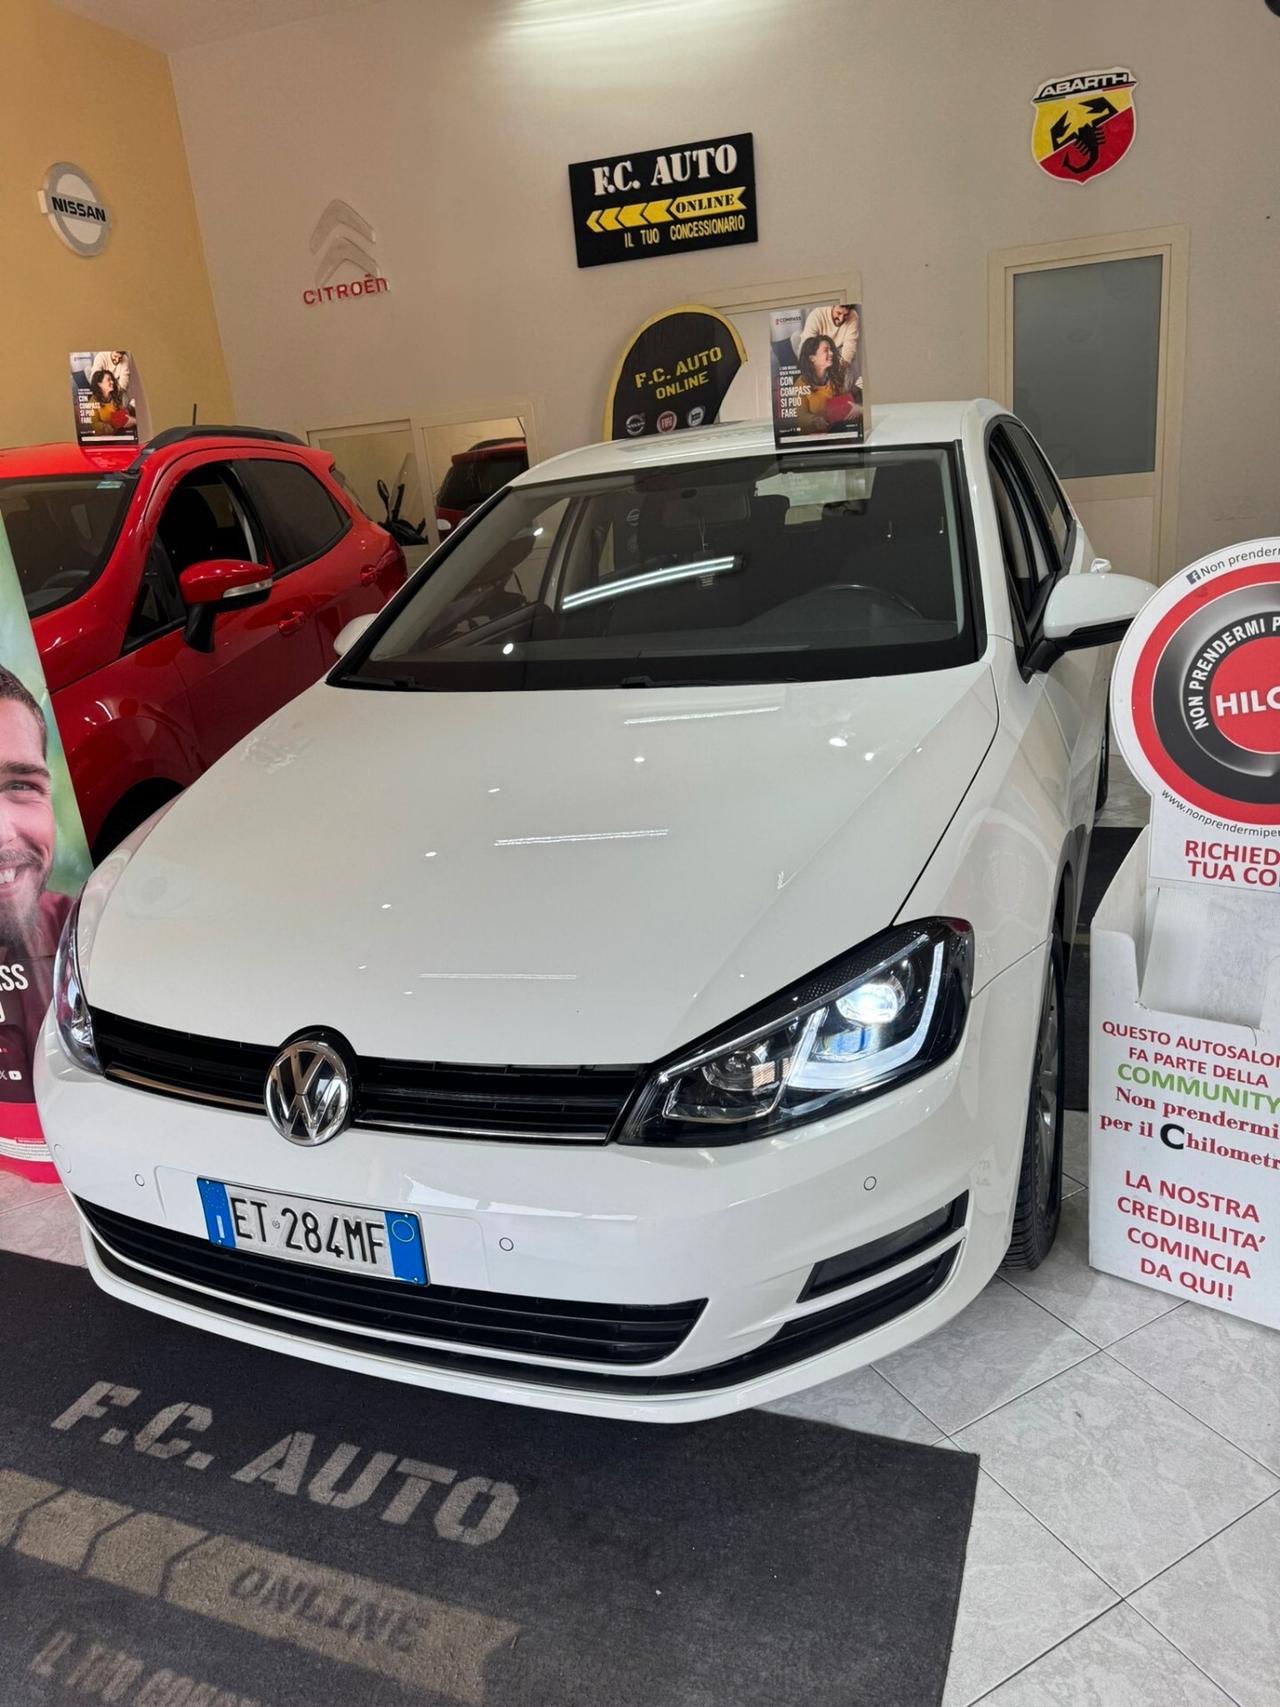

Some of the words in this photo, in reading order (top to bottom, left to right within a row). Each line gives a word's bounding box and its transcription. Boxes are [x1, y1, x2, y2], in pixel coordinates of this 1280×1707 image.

[1041, 74, 1128, 97] ABARTH
[592, 160, 641, 196] F.C.
[651, 144, 738, 187] AUTO
[51, 196, 107, 222] NISSAN
[675, 193, 735, 214] ONLINE
[624, 232, 635, 248] IL
[640, 228, 660, 245] TUO
[670, 214, 746, 241] CONCESSIONARIO
[634, 368, 672, 389] F.C.
[675, 346, 722, 377] AUTO
[655, 371, 710, 399] ONLINE
[1200, 560, 1226, 578] Non
[1228, 547, 1280, 567] prender
[1189, 618, 1266, 690] PRENDERMI
[1188, 696, 1209, 730] NON
[1161, 789, 1280, 839] www.nonprendermipe
[1187, 861, 1236, 882] TUA
[1243, 867, 1280, 887] CO
[0, 963, 29, 992] SS
[1102, 1021, 1171, 1046] QUESTO
[1176, 1036, 1280, 1068] AUTOSALO
[1117, 1063, 1280, 1114] COMMUNITY
[1129, 1047, 1149, 1062] FA
[1154, 1052, 1207, 1075] PARTE
[1213, 1064, 1269, 1088] DELLA
[1100, 1114, 1133, 1131] per
[1139, 1121, 1153, 1138] il
[1115, 1086, 1156, 1110] Non
[1162, 1101, 1280, 1139] prendermi
[1125, 1170, 1152, 1193] LA
[1159, 1180, 1260, 1223] NOSTRA
[1127, 1227, 1251, 1279] COMINCIA
[1140, 1257, 1172, 1282] DA
[1179, 1271, 1233, 1301] QUI!
[50, 1380, 215, 1470] F.C.
[230, 1431, 520, 1546] AUTO
[231, 1566, 430, 1652] ONLINE
